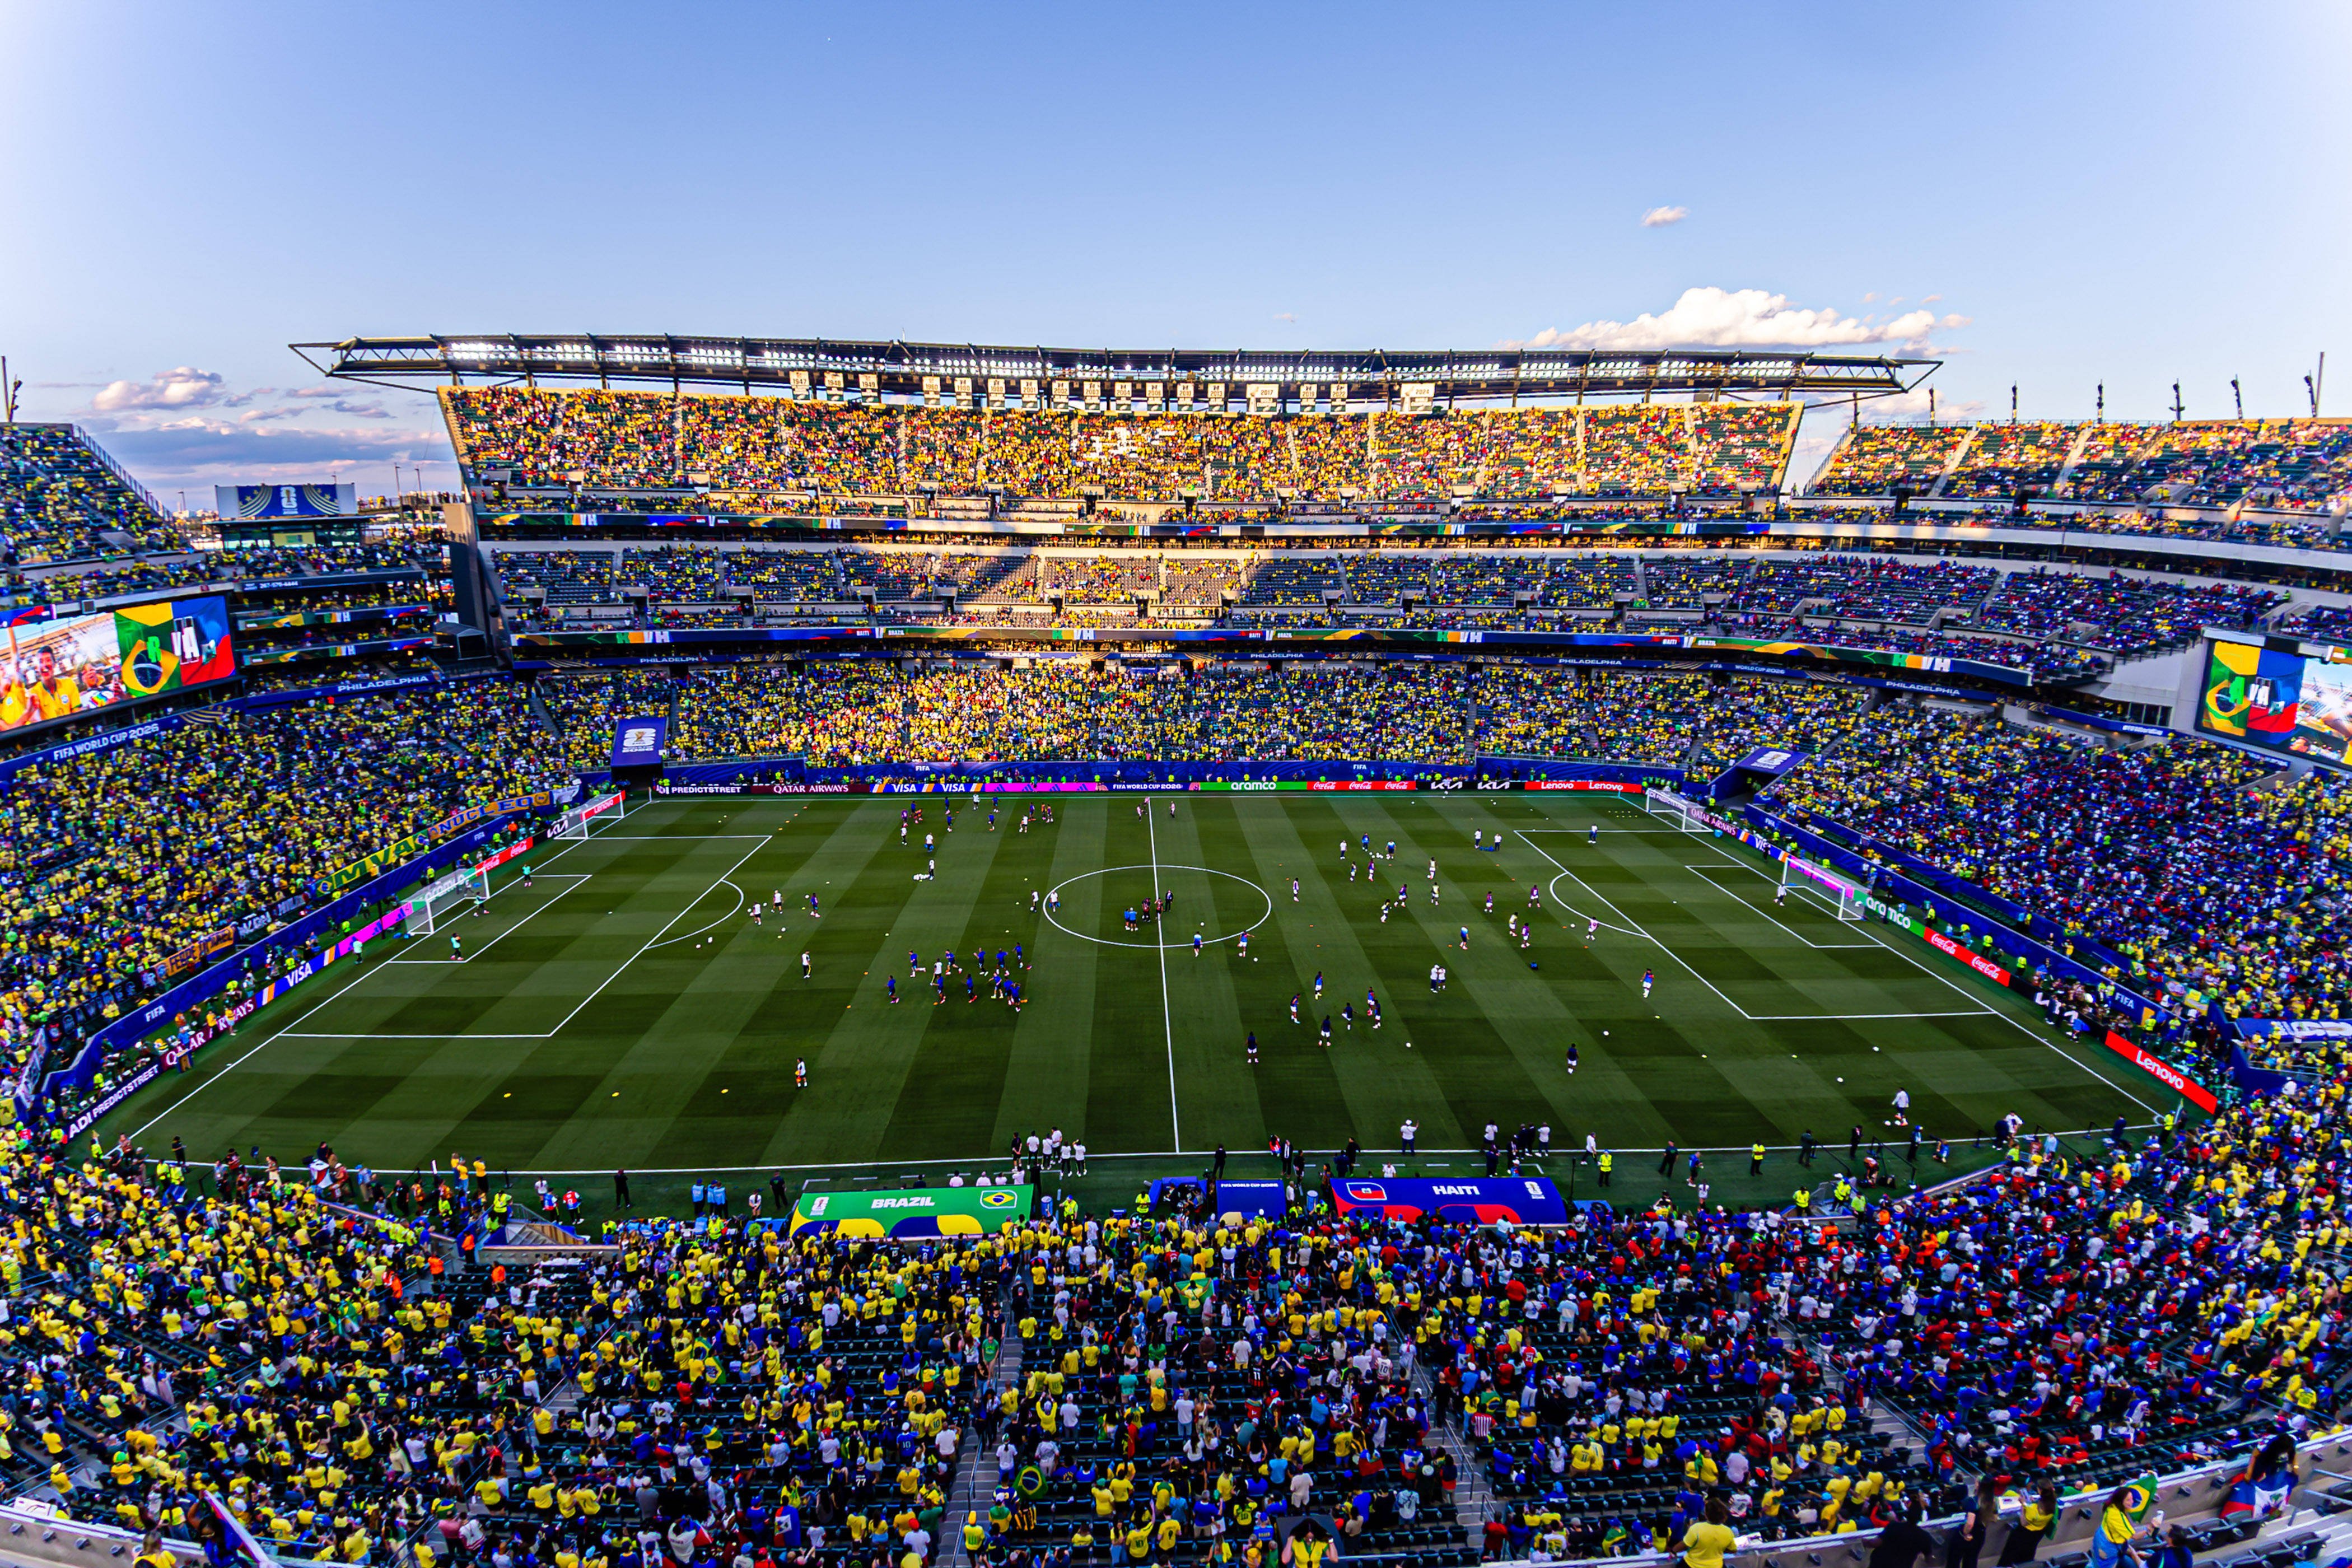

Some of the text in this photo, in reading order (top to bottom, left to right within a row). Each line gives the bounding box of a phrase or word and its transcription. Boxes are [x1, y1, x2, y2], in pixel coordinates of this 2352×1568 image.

[337, 675, 430, 692] PHILADELPHIA
[1886, 680, 1960, 694] PHILADELPHIA
[54, 723, 160, 761] FIFA WORLD CUP 2026
[773, 785, 806, 794] QATAR
[892, 783, 917, 792] VISA
[941, 783, 965, 792] VISA
[1313, 781, 1337, 790] Coca-Cola
[1349, 781, 1373, 790] Coca-Cola
[1385, 781, 1409, 790] Coca-Cola
[1477, 781, 1510, 790] KIA
[1589, 782, 1623, 791] Lenovo
[594, 799, 614, 814] Lenovo
[1691, 808, 1737, 836] QATAR AIRWAYS
[1865, 896, 1911, 929] aramco
[284, 962, 313, 987] VISA
[2115, 992, 2134, 1009] FIFA
[145, 1005, 166, 1023] FIFA
[2135, 1049, 2185, 1090] Lenovo
[69, 1112, 93, 1138] ADI
[92, 1064, 159, 1118] PREDICTSTREET
[1432, 1186, 1480, 1195] HAITI
[871, 1197, 935, 1209] BRAZIL
